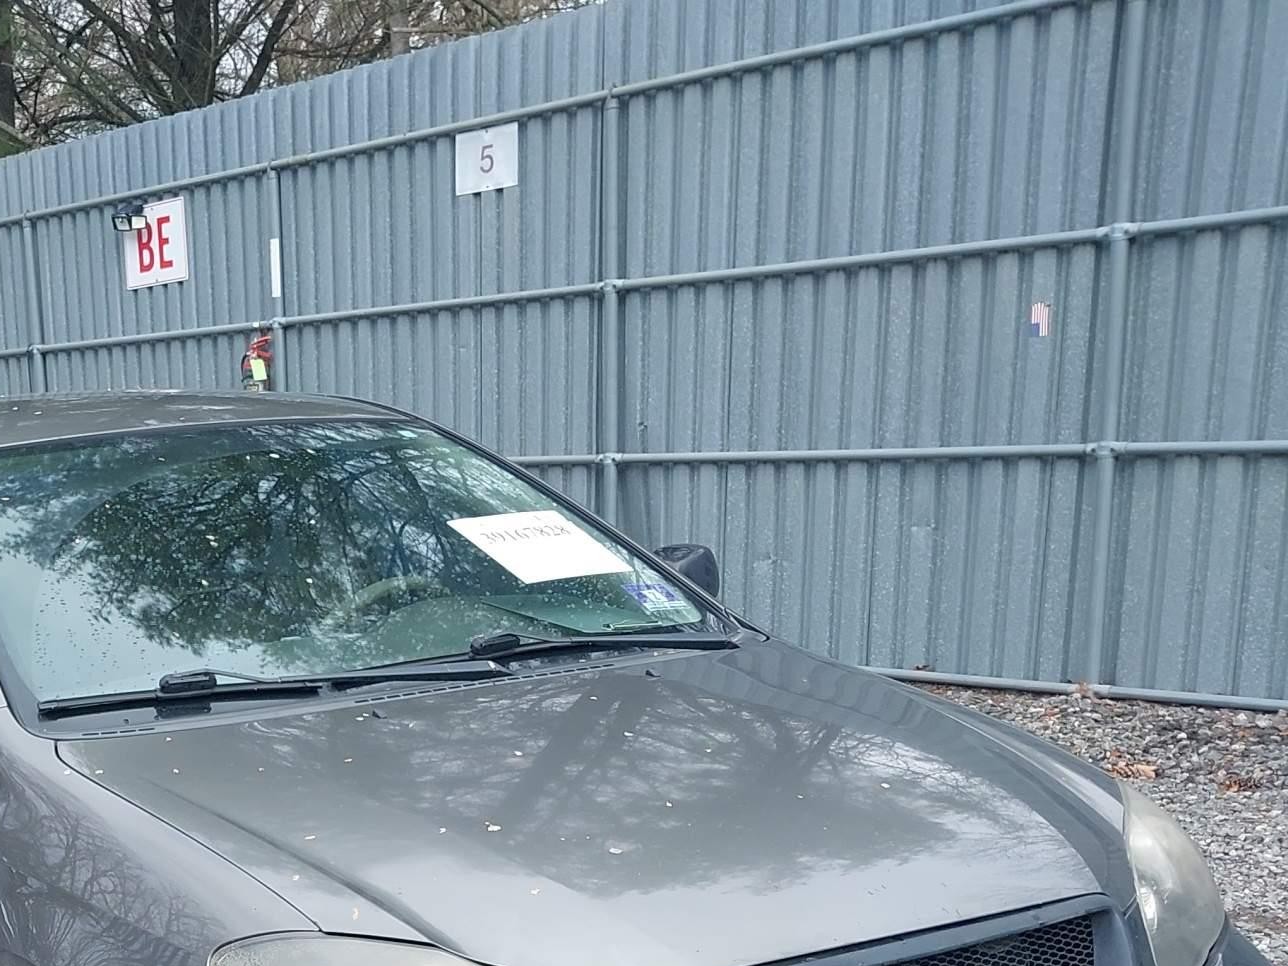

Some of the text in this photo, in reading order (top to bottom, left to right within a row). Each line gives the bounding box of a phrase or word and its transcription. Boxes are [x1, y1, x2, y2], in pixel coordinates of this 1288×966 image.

[479, 143, 494, 174] 5
[137, 215, 174, 274] BE
[479, 524, 572, 544] 39167828
